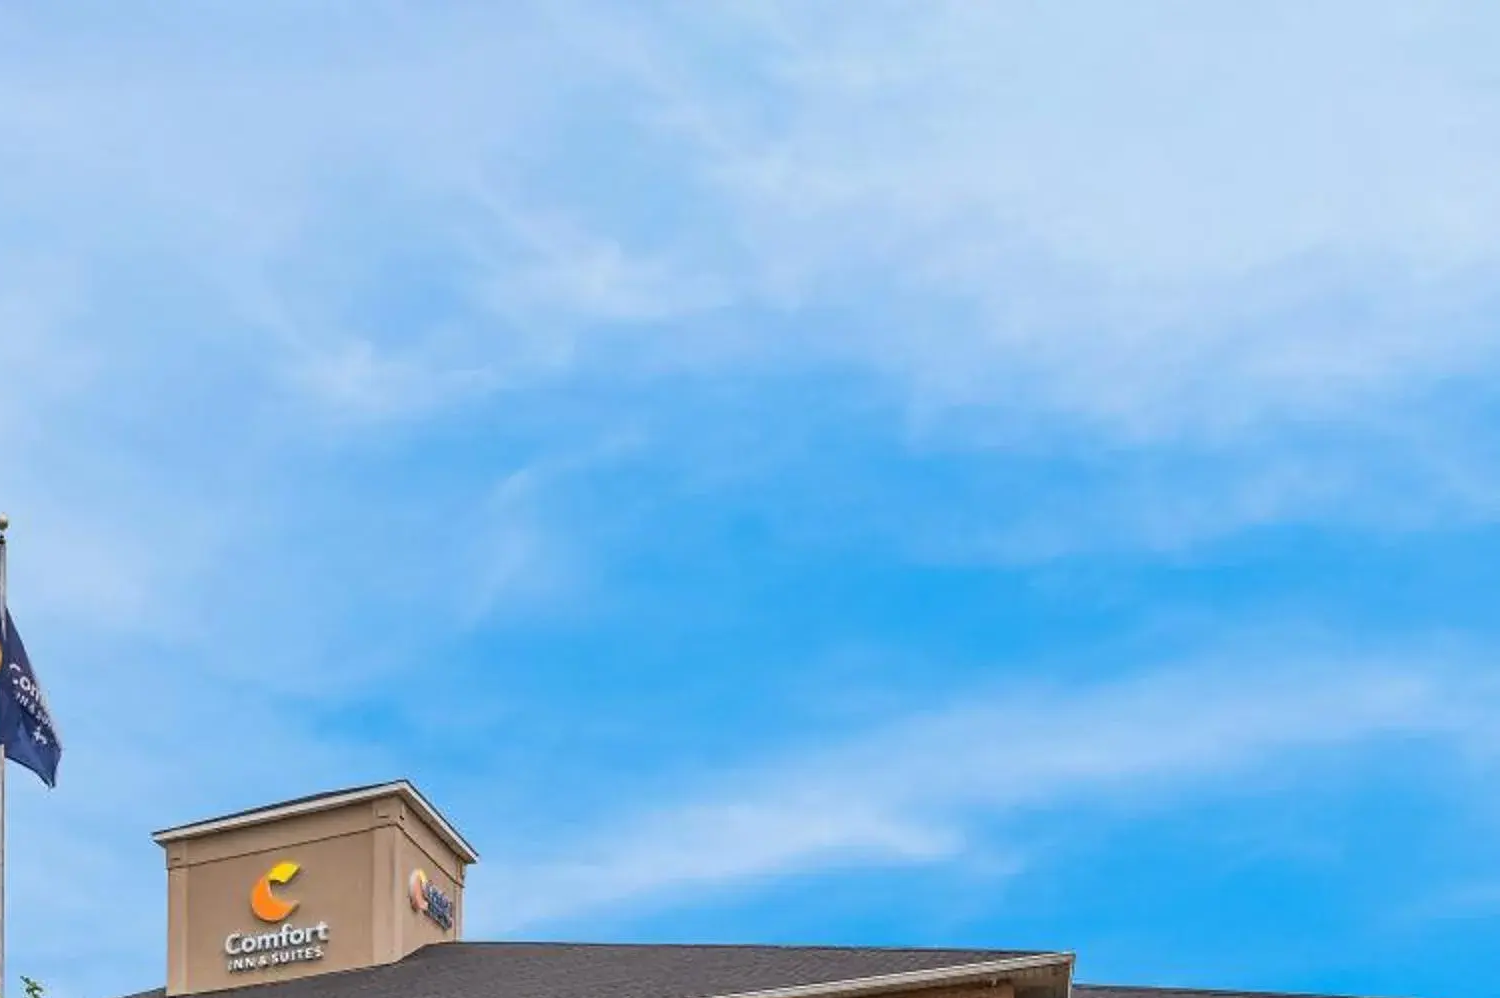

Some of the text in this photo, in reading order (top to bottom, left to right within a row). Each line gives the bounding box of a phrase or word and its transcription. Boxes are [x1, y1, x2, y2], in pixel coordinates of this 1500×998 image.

[225, 920, 329, 955] Comfort
[227, 945, 324, 972] INN & SUITES
